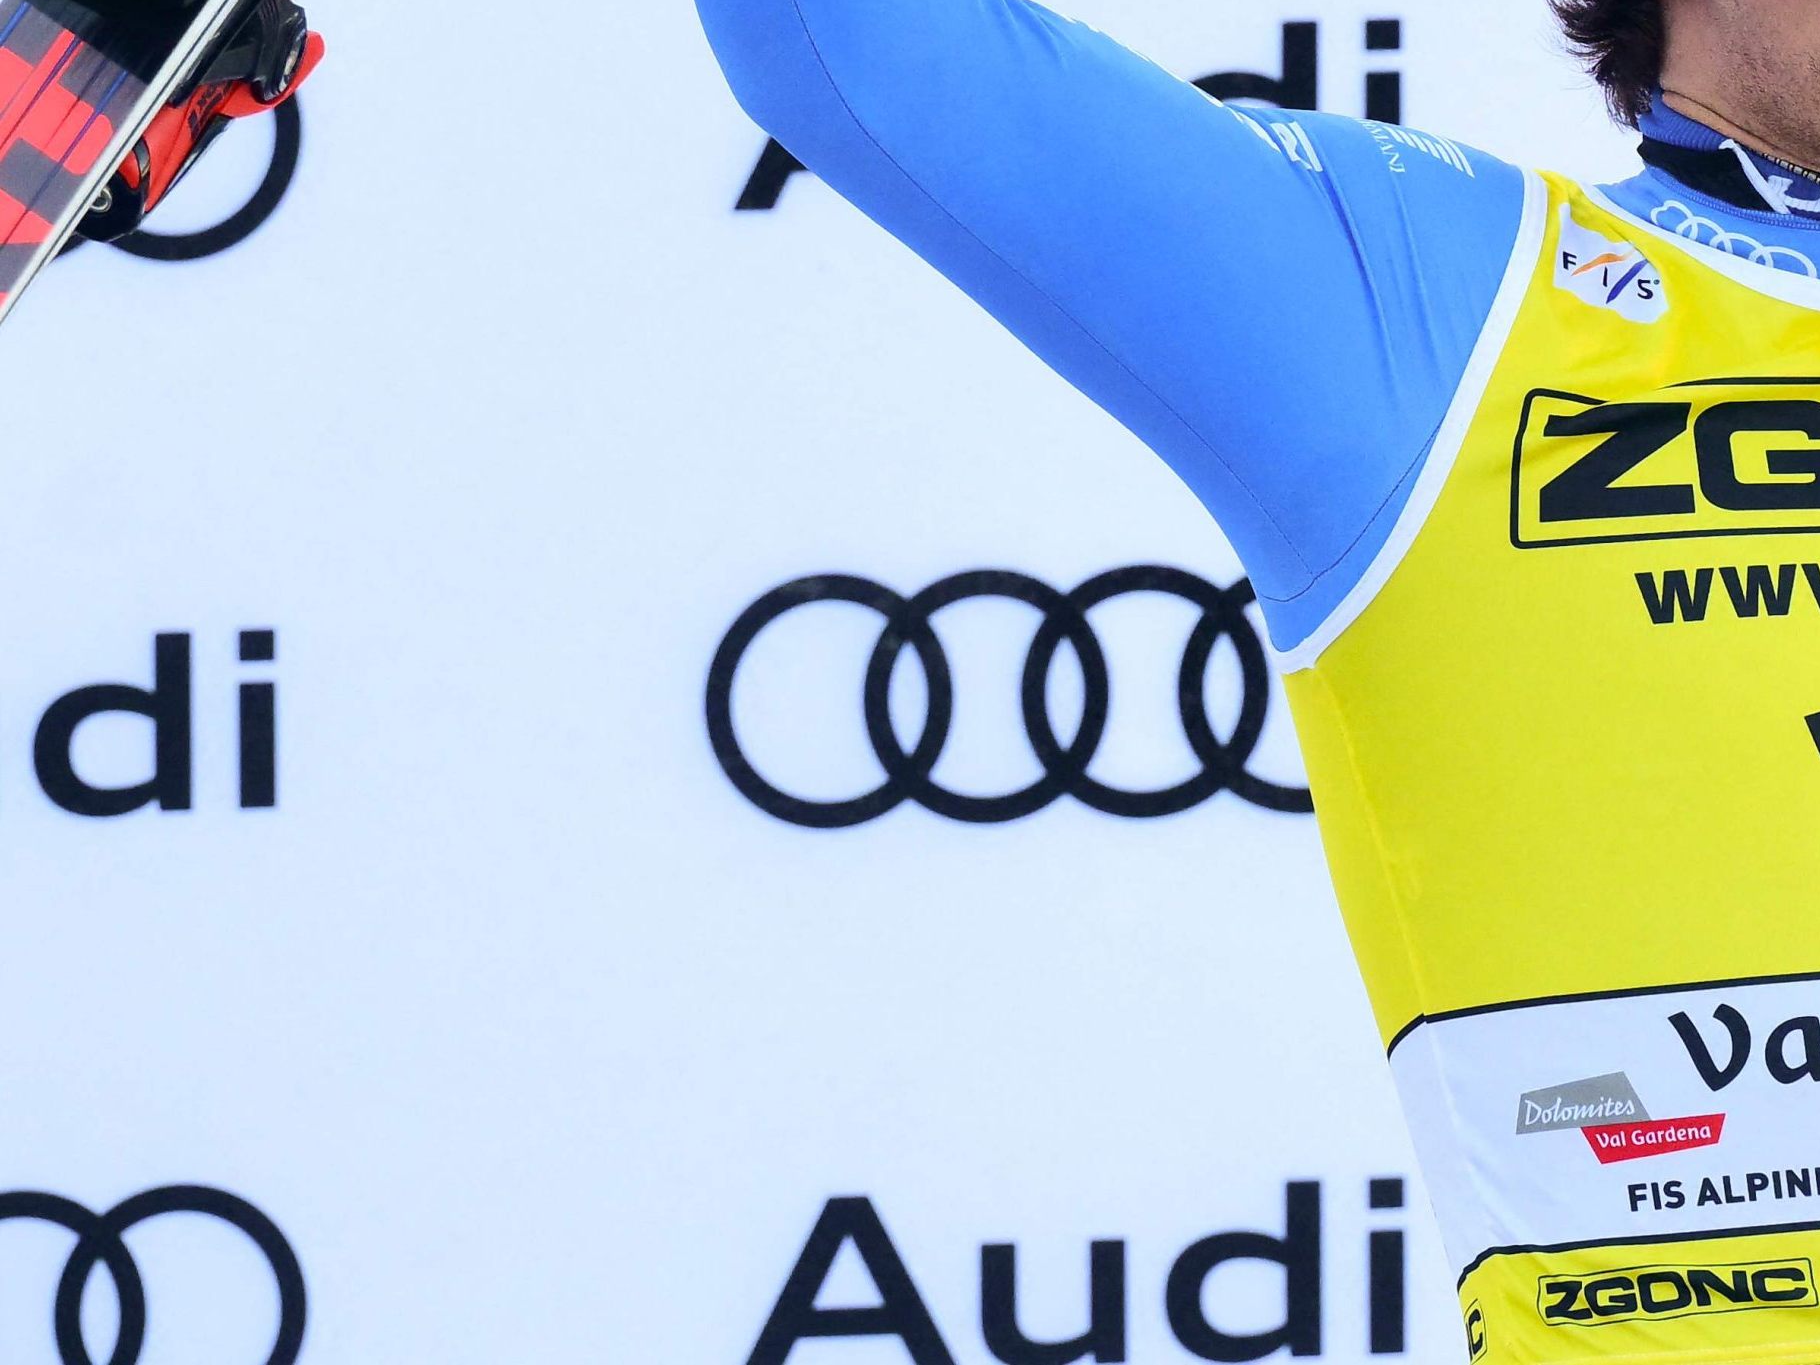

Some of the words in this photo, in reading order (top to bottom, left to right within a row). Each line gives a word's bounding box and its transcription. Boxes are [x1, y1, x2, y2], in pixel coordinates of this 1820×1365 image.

[1562, 250, 1656, 301] FIS
[1523, 1096, 1636, 1126] Dolomites
[1595, 1131, 1626, 1148] Val
[1631, 1124, 1712, 1145] Gardena
[1627, 1180, 1686, 1212] FIS
[745, 1177, 1405, 1365] Audi
[1545, 1267, 1810, 1321] ZGONC
